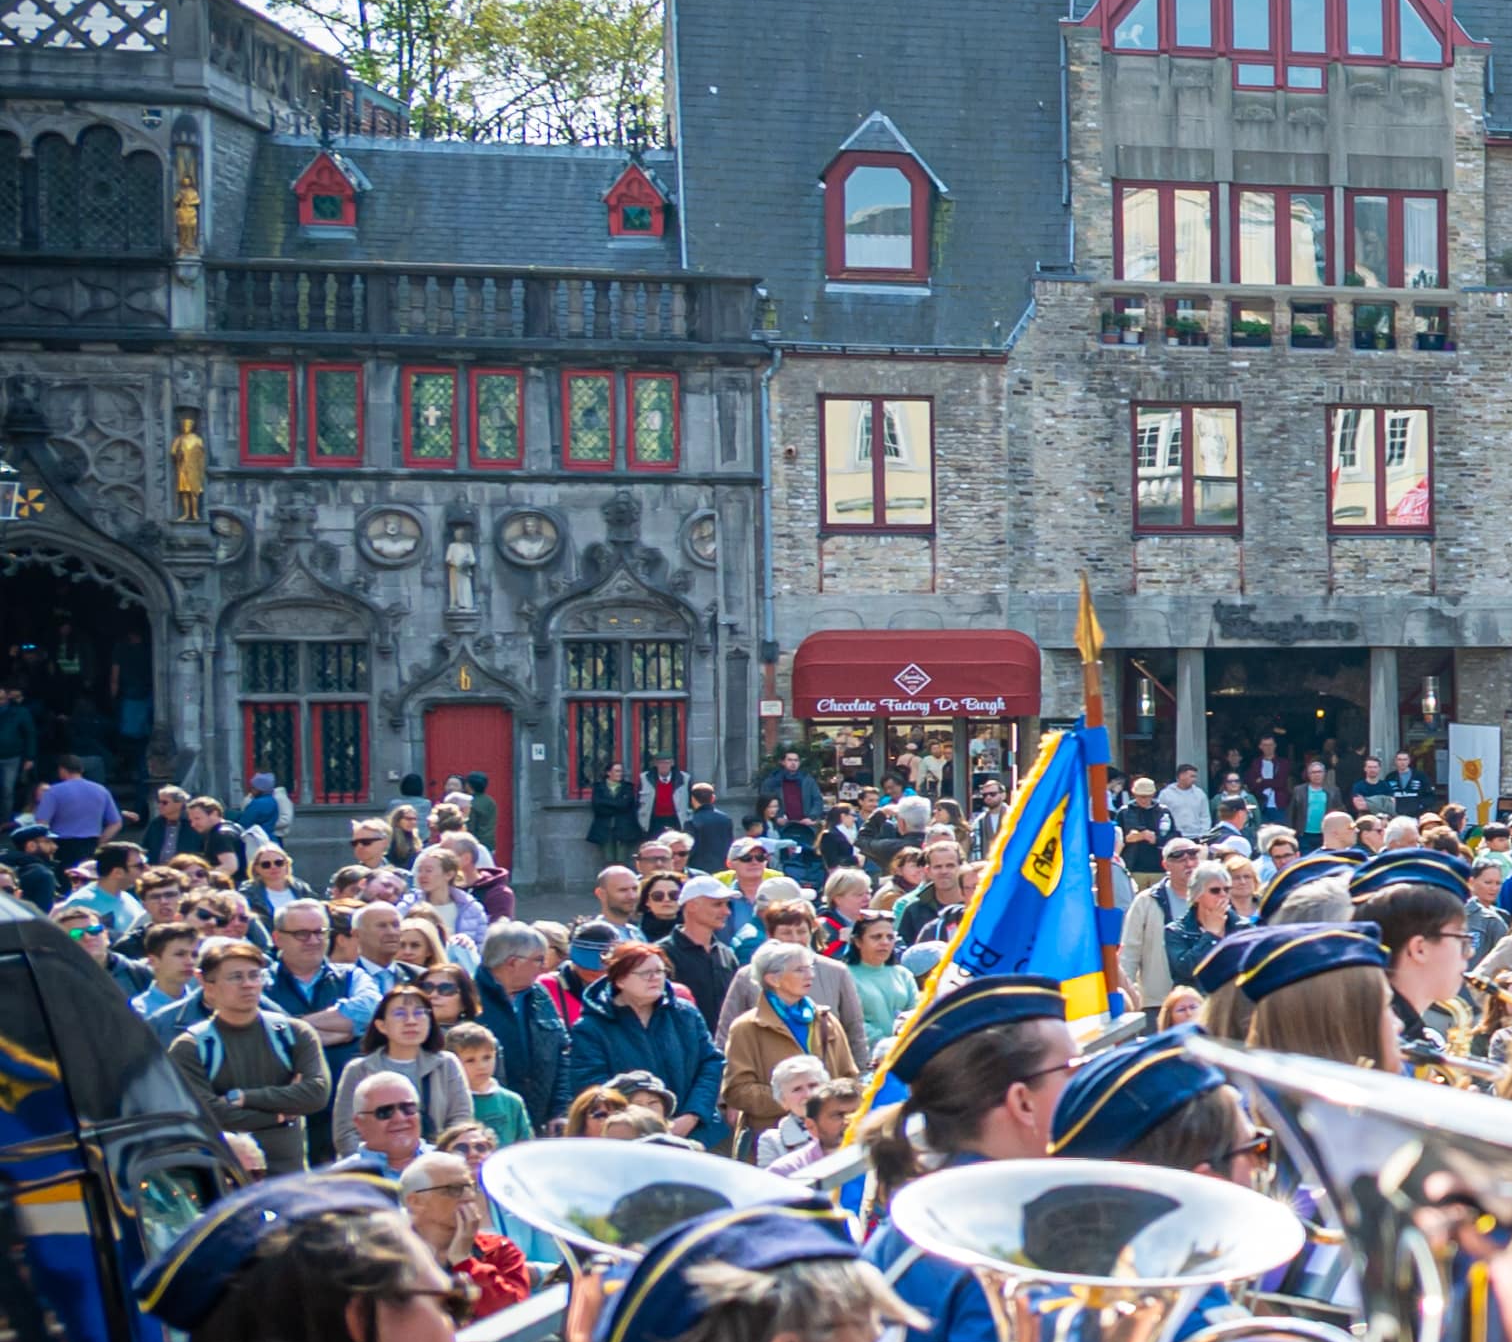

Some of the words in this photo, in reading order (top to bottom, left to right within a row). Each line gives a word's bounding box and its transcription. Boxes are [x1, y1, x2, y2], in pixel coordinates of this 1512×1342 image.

[816, 698, 877, 713] Chocolate
[879, 698, 930, 716] Factory
[933, 698, 959, 712] De
[961, 696, 1006, 715] Burgh
